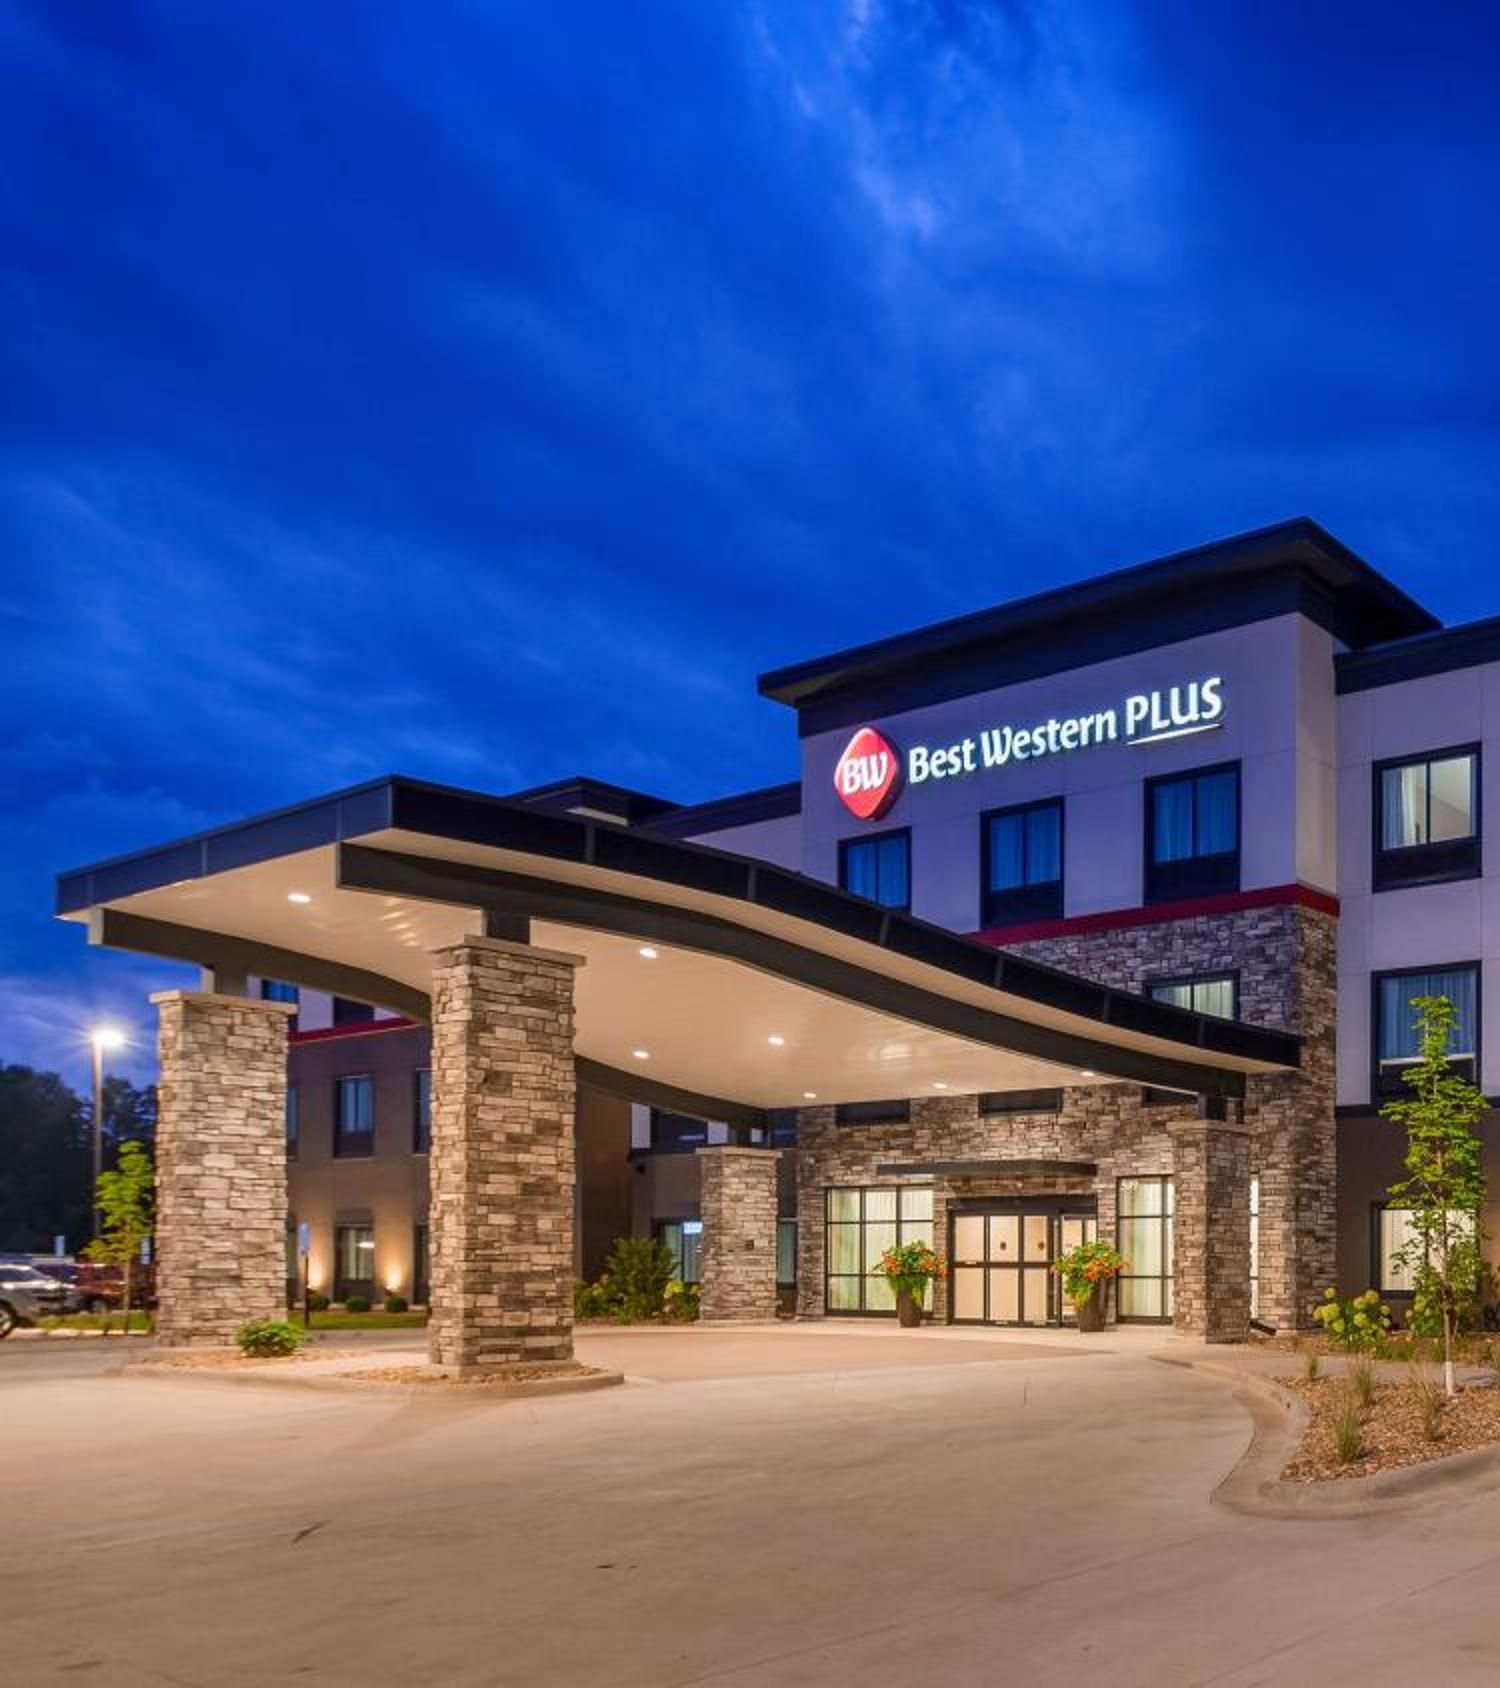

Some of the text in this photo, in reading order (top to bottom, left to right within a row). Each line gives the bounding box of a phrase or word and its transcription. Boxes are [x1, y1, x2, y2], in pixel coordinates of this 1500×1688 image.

[908, 677, 1223, 784] Best Western PLUS
[842, 753, 888, 795] BW
